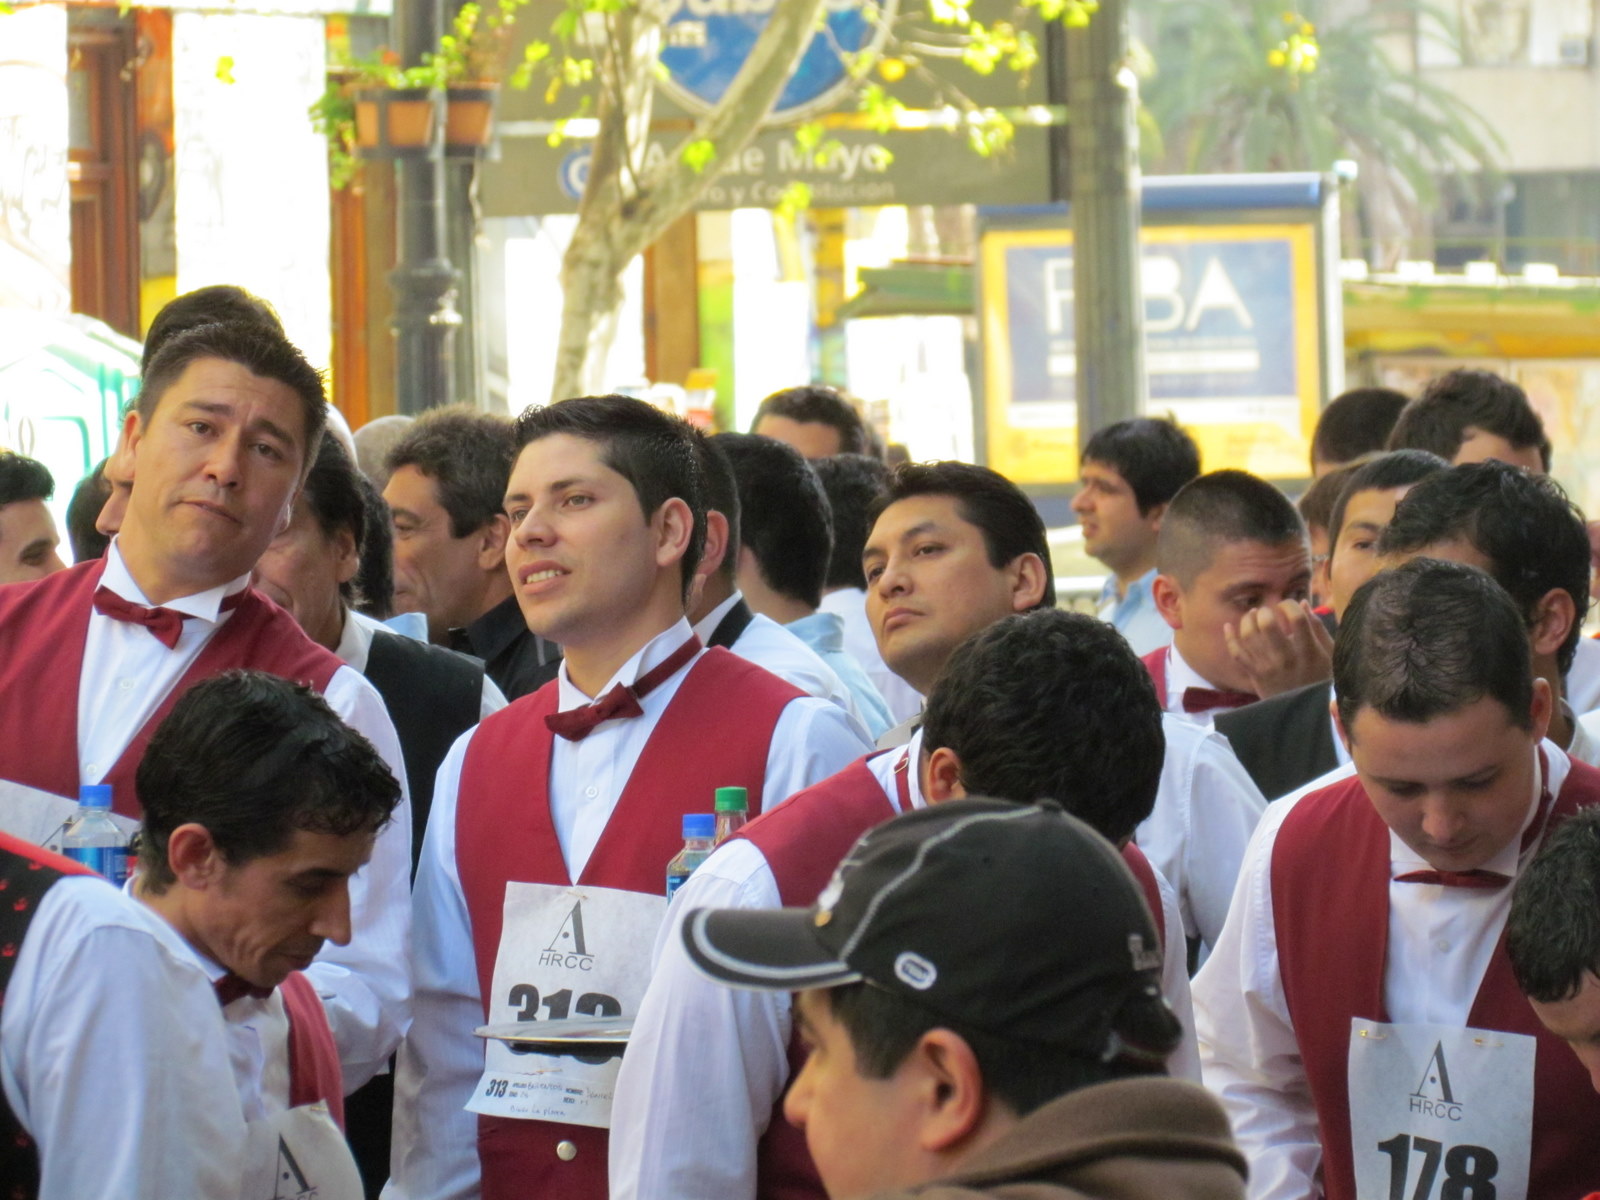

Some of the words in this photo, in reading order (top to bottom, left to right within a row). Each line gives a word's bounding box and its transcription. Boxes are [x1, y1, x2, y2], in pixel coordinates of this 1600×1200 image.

[777, 138, 890, 181] Mayo
[538, 952, 595, 972] HRCC
[485, 1079, 509, 1098] 313
[1409, 1097, 1463, 1122] HRCC
[1377, 1132, 1499, 1200] 178
